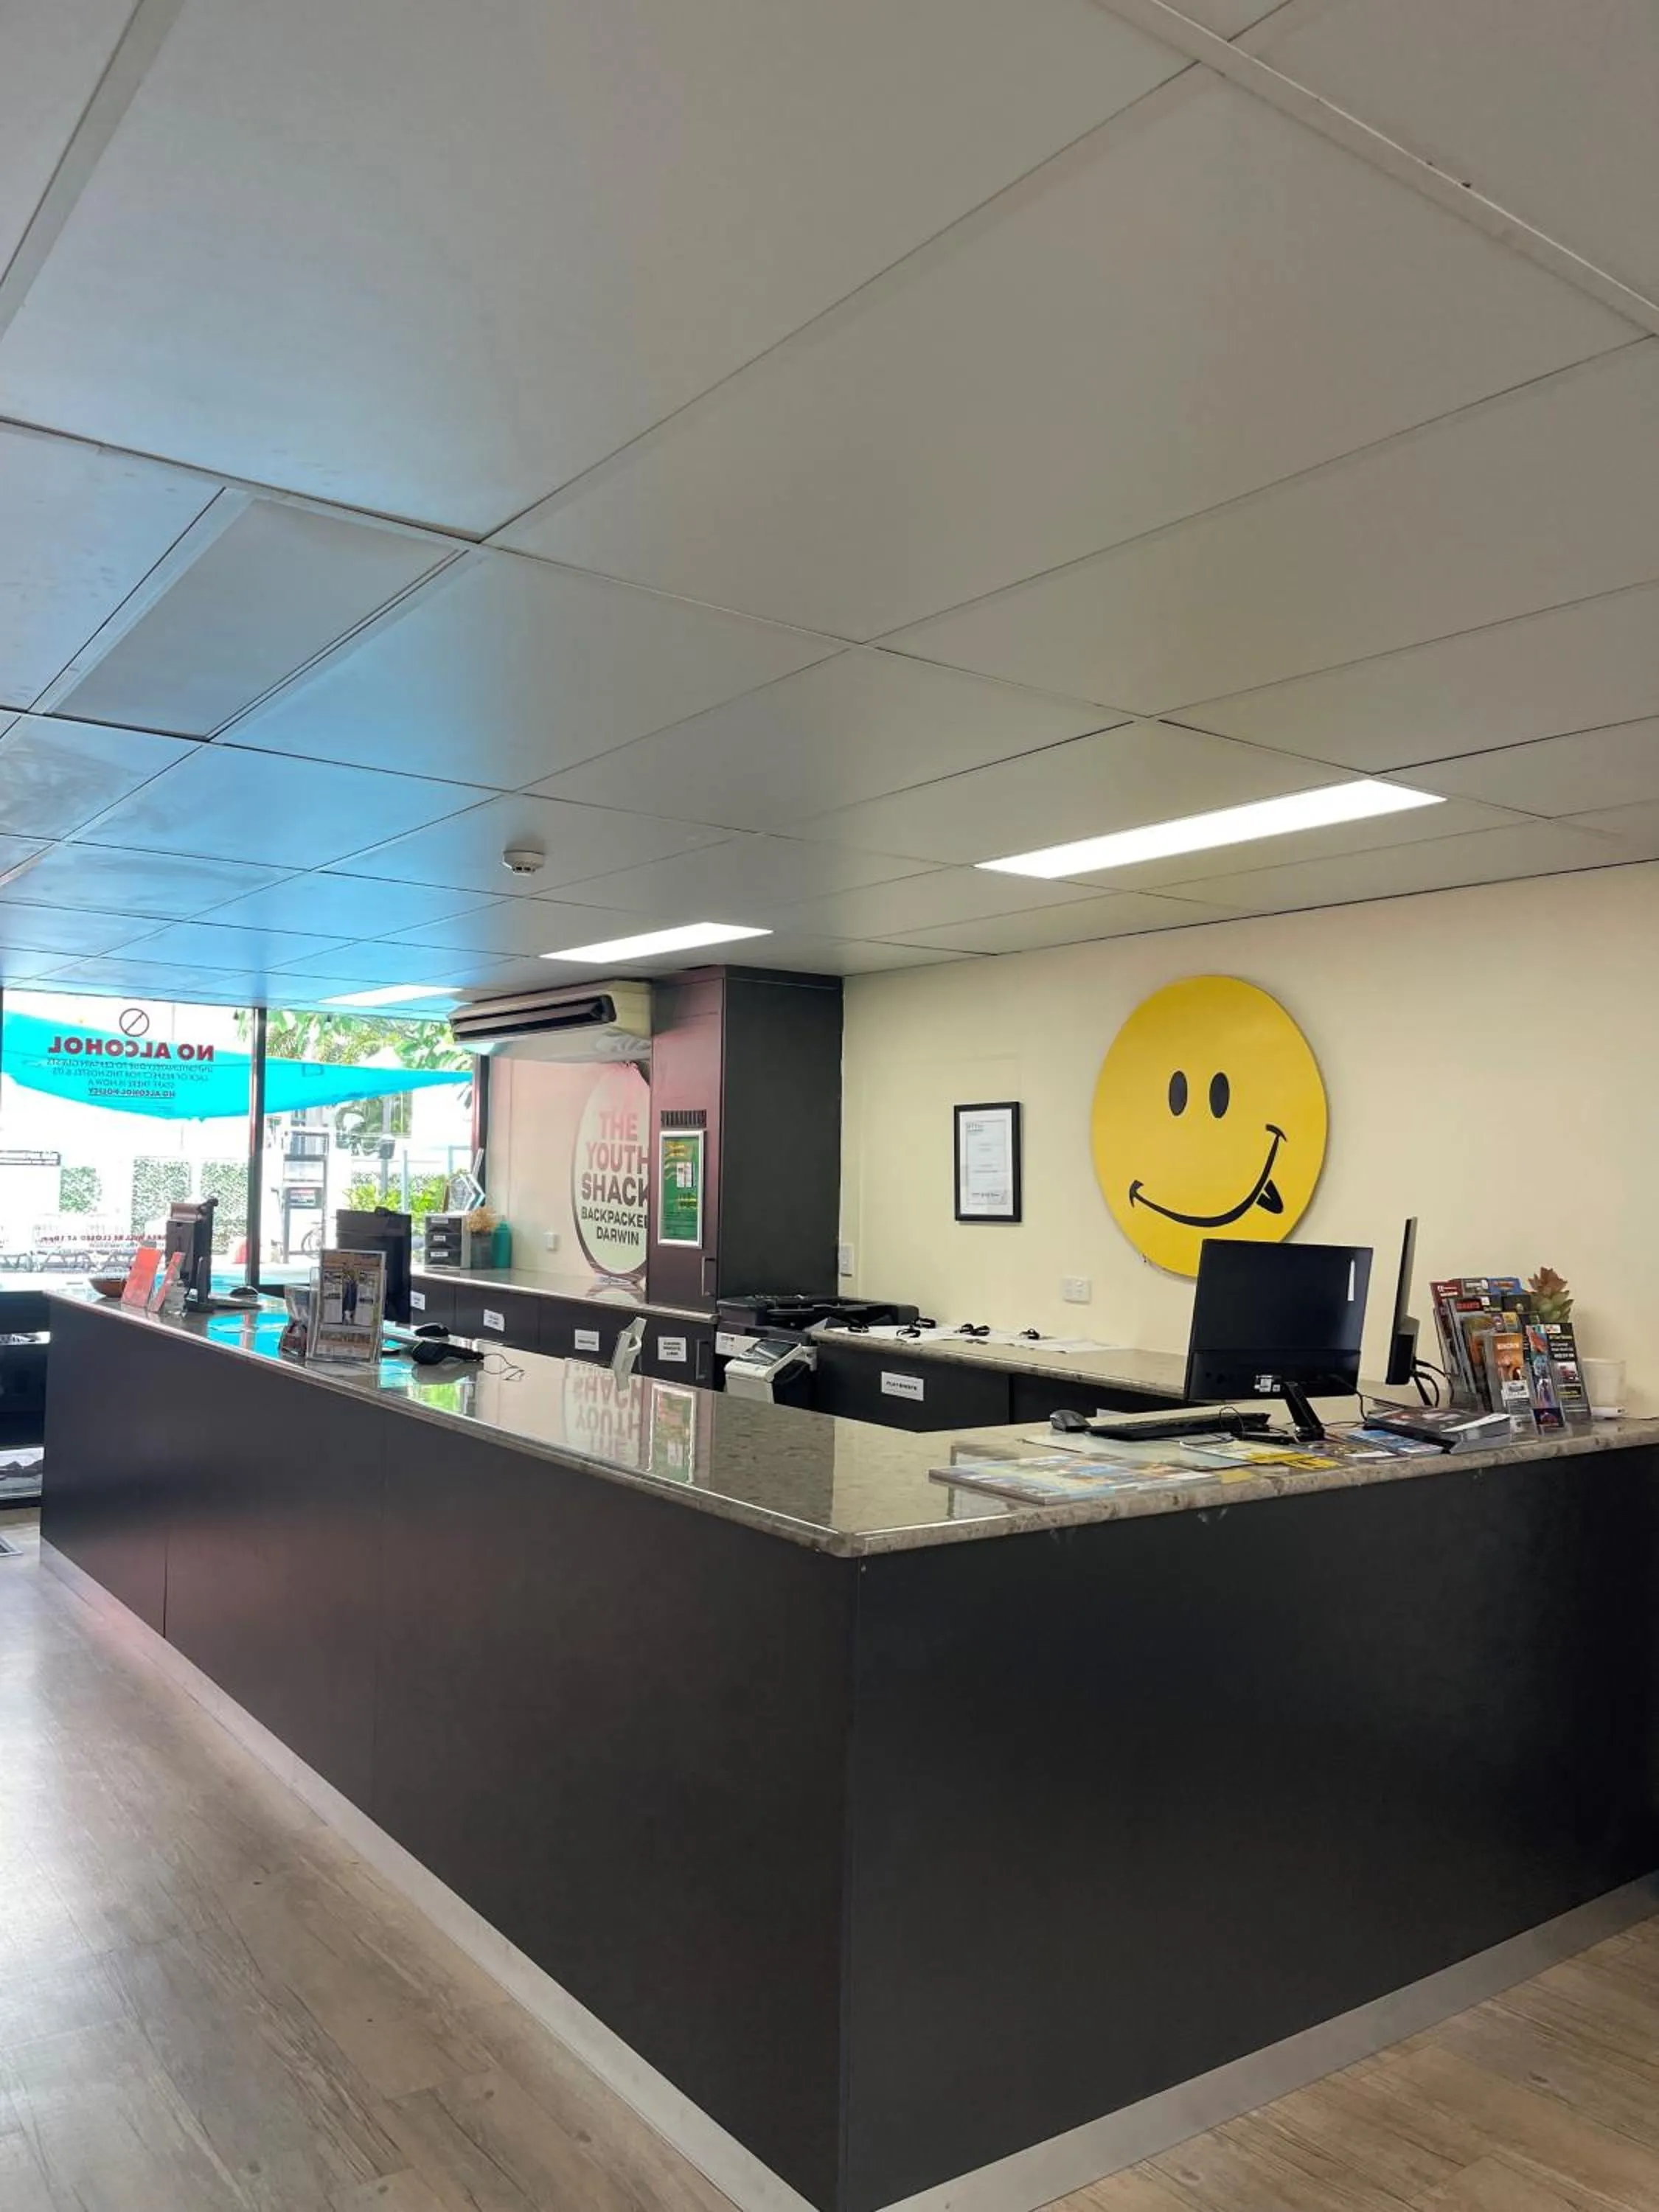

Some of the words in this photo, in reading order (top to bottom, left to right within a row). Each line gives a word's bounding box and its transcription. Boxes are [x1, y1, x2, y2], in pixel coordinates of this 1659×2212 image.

[599, 1111, 639, 1141] THE
[585, 1142, 649, 1175] YOUTH
[581, 1171, 649, 1208] SHACK
[597, 1226, 639, 1245] DARWIN
